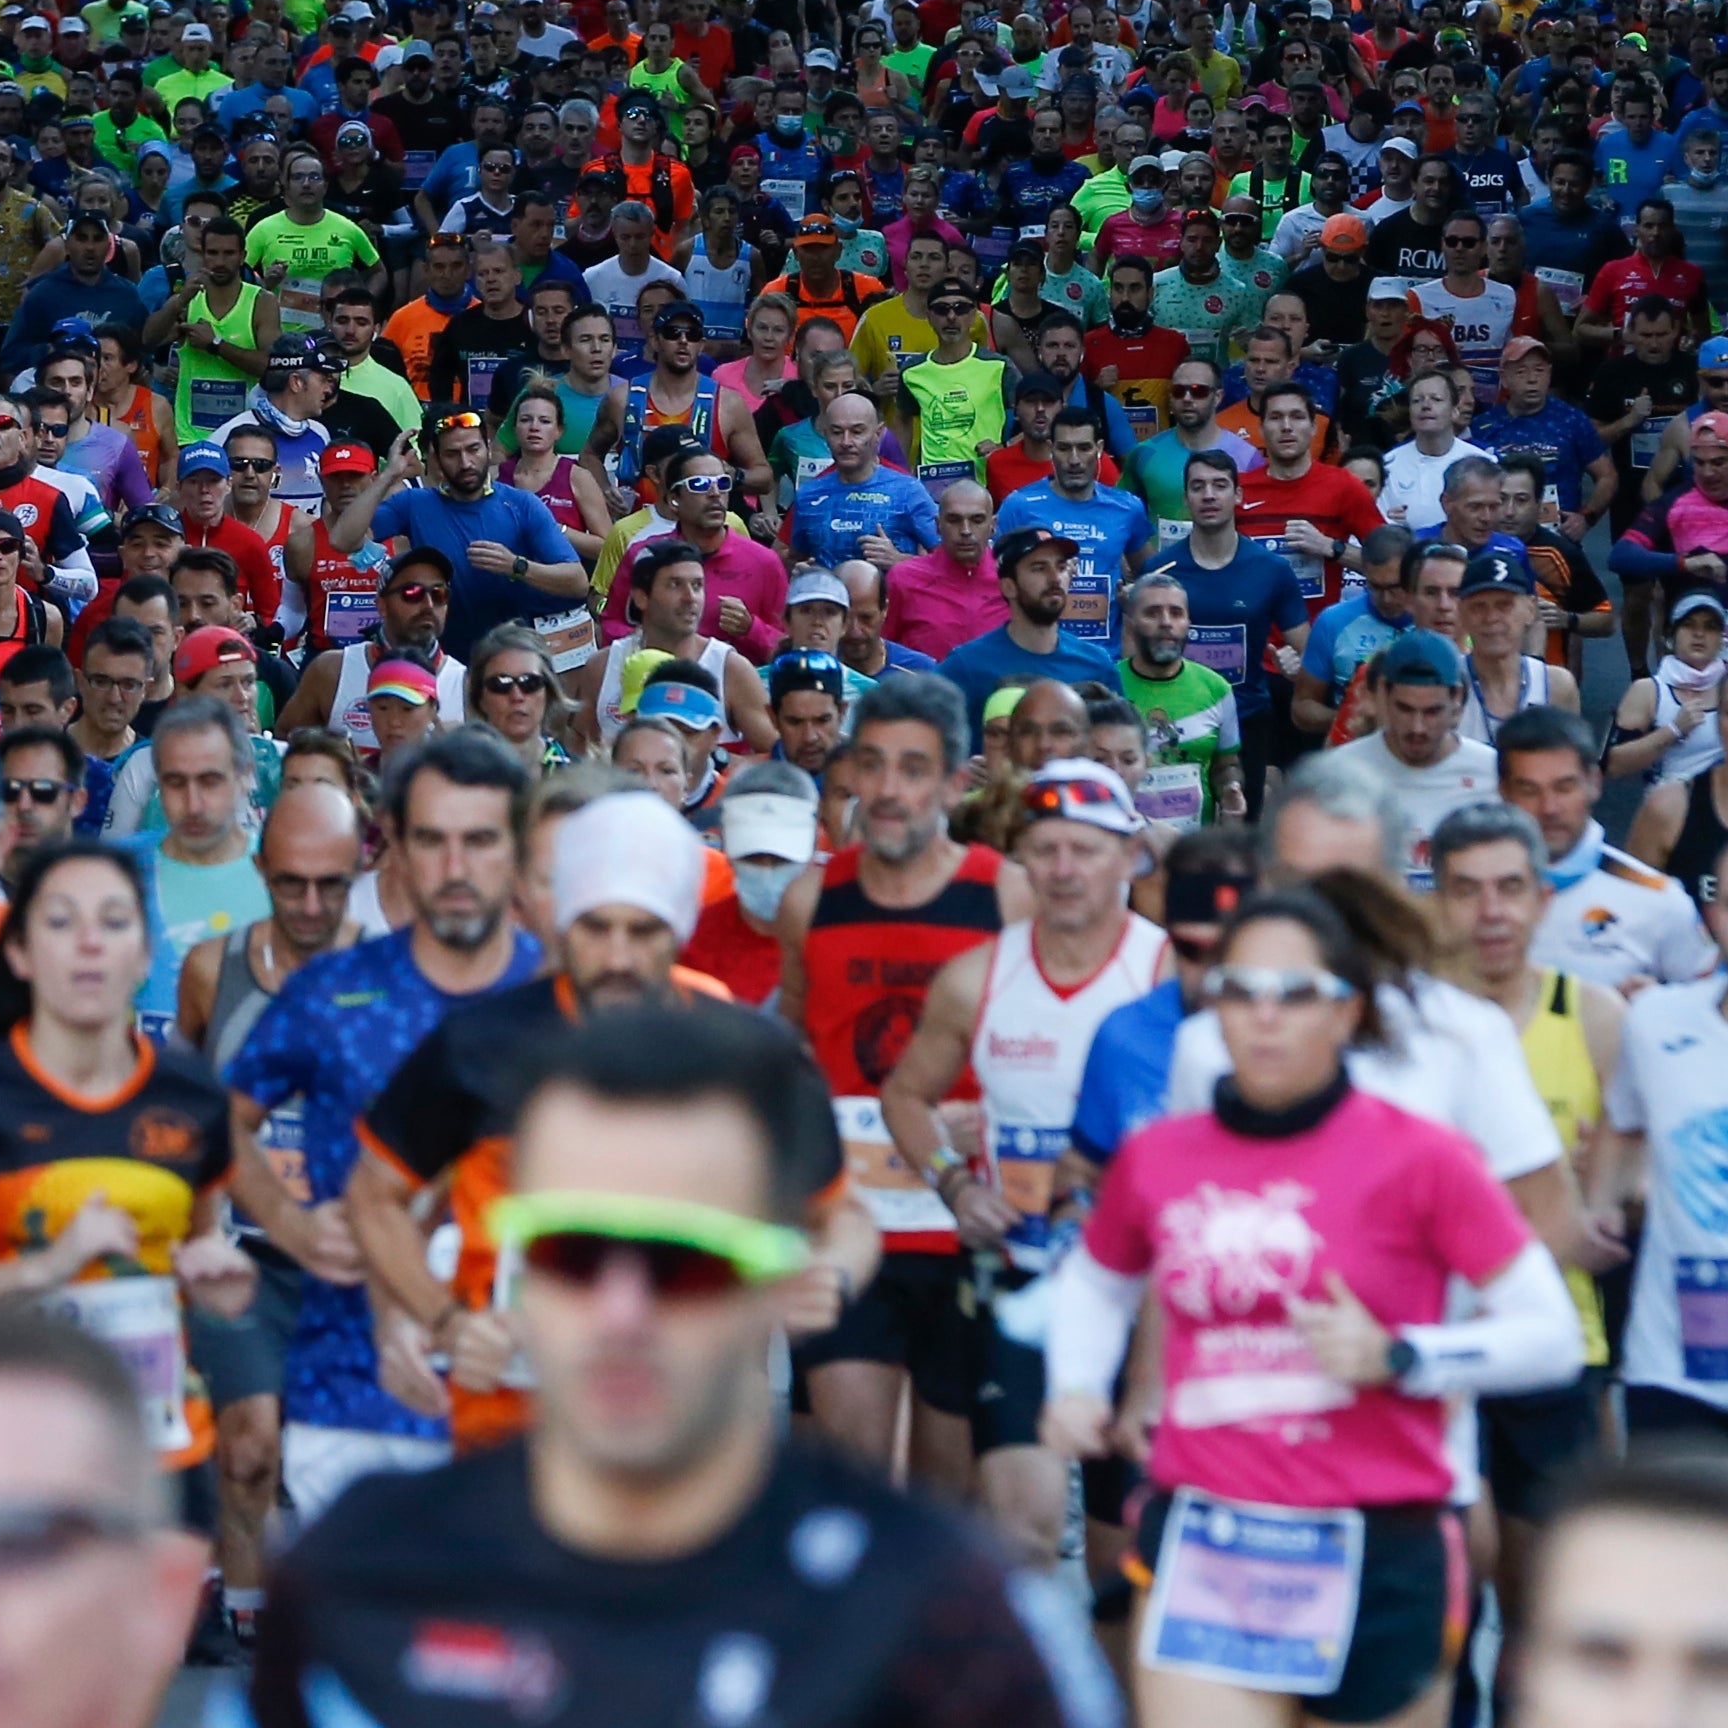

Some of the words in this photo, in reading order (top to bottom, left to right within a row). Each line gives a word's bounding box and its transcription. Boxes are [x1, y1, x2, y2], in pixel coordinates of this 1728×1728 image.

[1609, 158, 1628, 184] R
[1470, 174, 1503, 187] asics
[1398, 248, 1446, 271] RCM
[269, 356, 304, 367] SPORT
[1200, 631, 1232, 639] ZURICH
